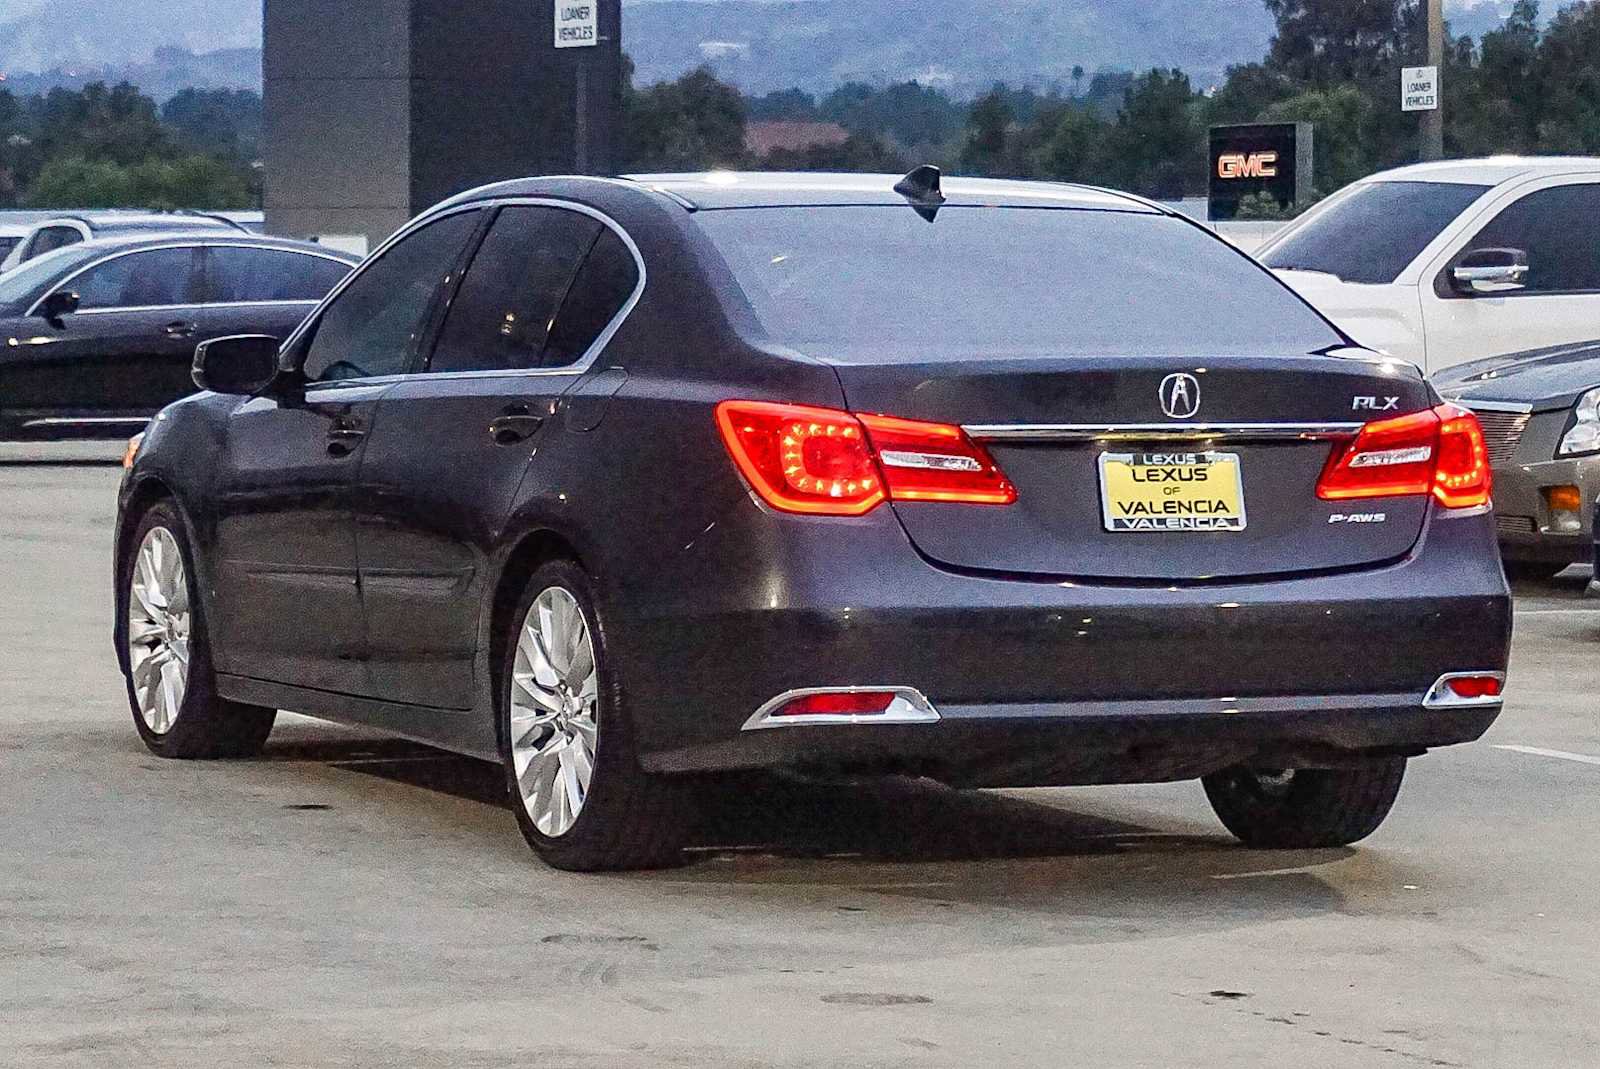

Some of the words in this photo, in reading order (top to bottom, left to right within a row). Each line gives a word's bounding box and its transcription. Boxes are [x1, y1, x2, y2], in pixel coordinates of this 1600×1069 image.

[560, 6, 590, 21] LOANER
[558, 25, 593, 41] VEHICLES
[1407, 82, 1432, 93] LOANER
[1405, 95, 1435, 107] VEHICLES
[1218, 152, 1277, 178] GMC
[1351, 395, 1400, 411] RLX
[1142, 453, 1197, 465] LEXUS
[1131, 468, 1208, 482] LEXUS
[1163, 486, 1181, 496] OF
[1117, 499, 1231, 515] VALENCIA
[1121, 517, 1233, 529] VALENCIA
[1327, 512, 1386, 524] P-AWS
